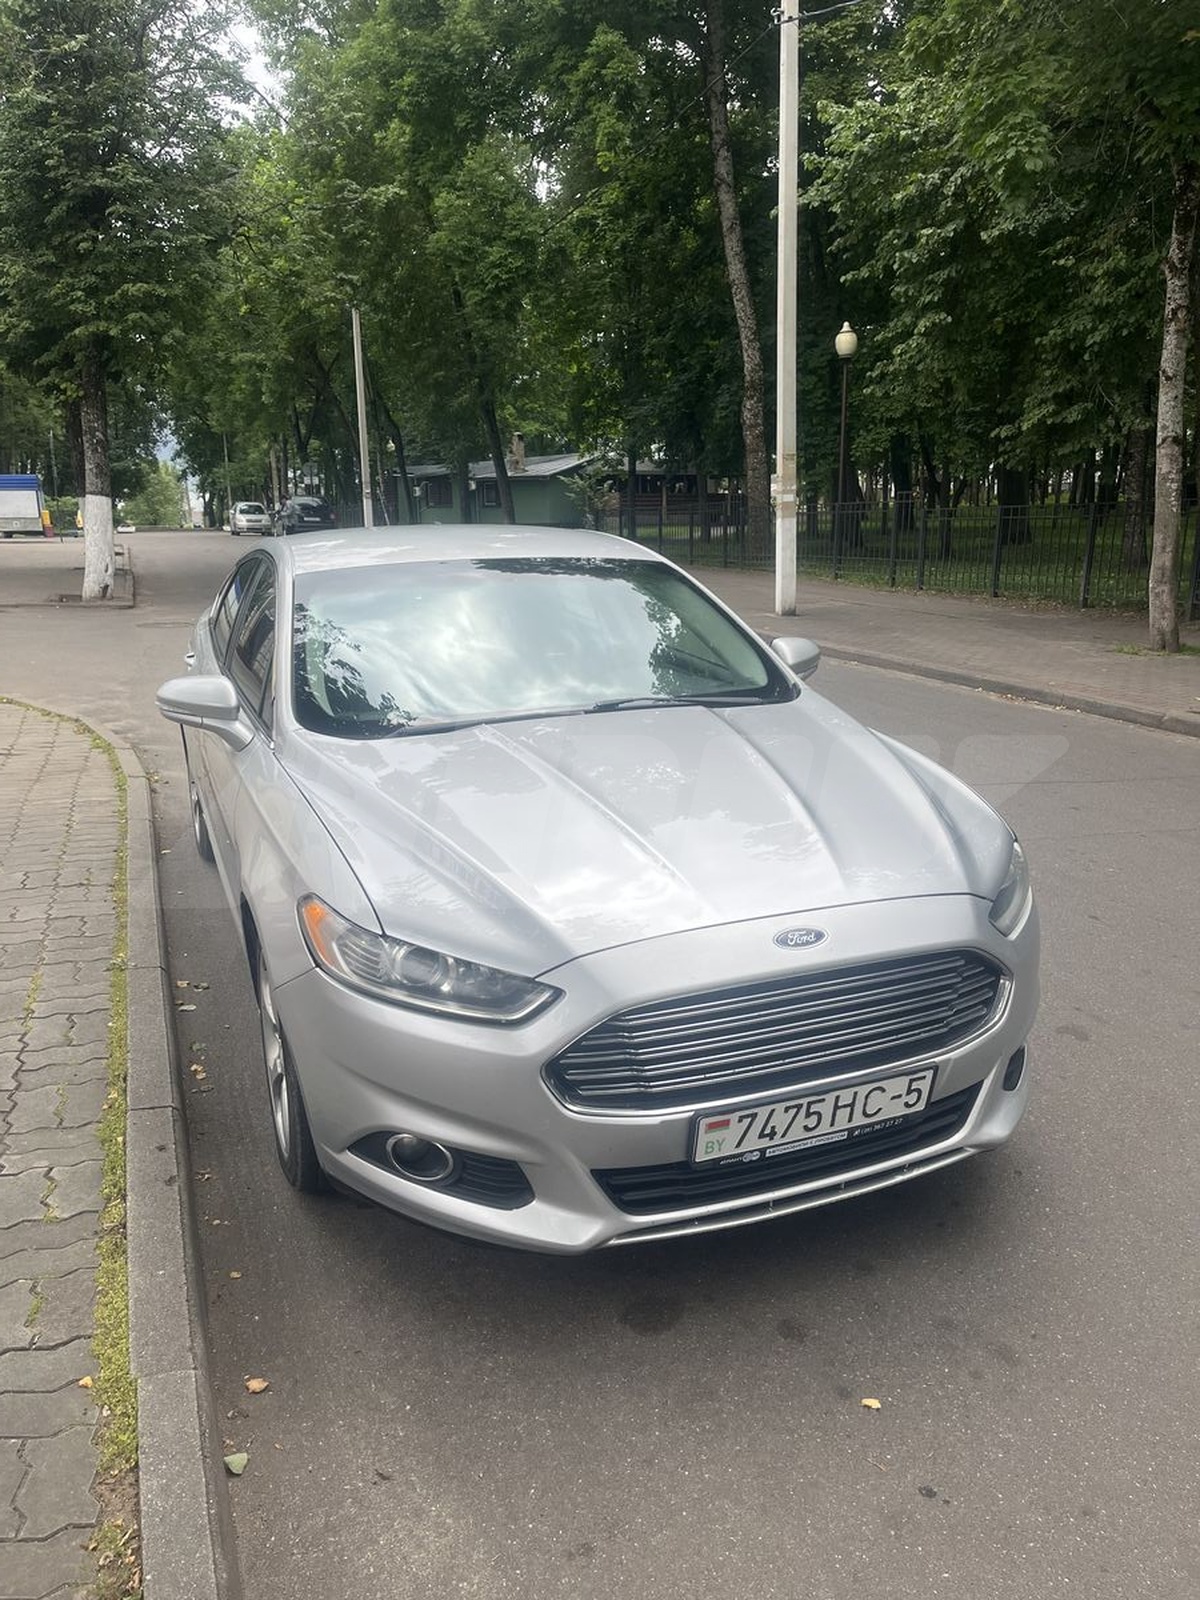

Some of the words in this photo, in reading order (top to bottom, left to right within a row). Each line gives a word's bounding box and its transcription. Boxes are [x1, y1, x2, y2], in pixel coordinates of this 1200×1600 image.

[787, 931, 816, 945] Ford
[734, 1075, 927, 1148] 7475HC-5
[704, 1138, 726, 1155] BY
